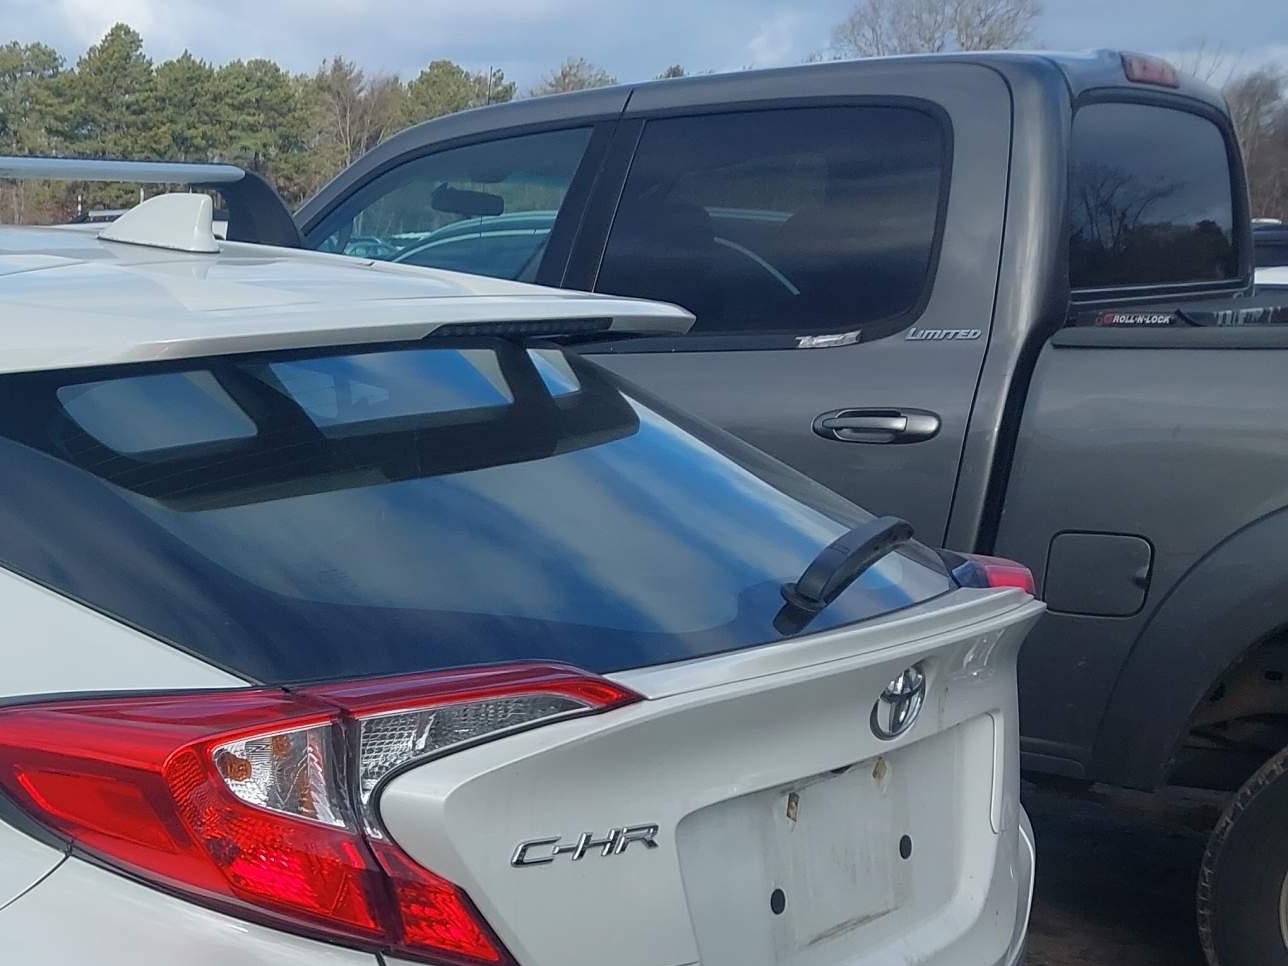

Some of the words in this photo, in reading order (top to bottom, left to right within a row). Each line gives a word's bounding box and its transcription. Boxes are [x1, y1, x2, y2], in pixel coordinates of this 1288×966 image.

[1112, 313, 1172, 324] ROLL-N-LOCK
[905, 327, 982, 341] LIMITED
[511, 823, 659, 868] C-HR
